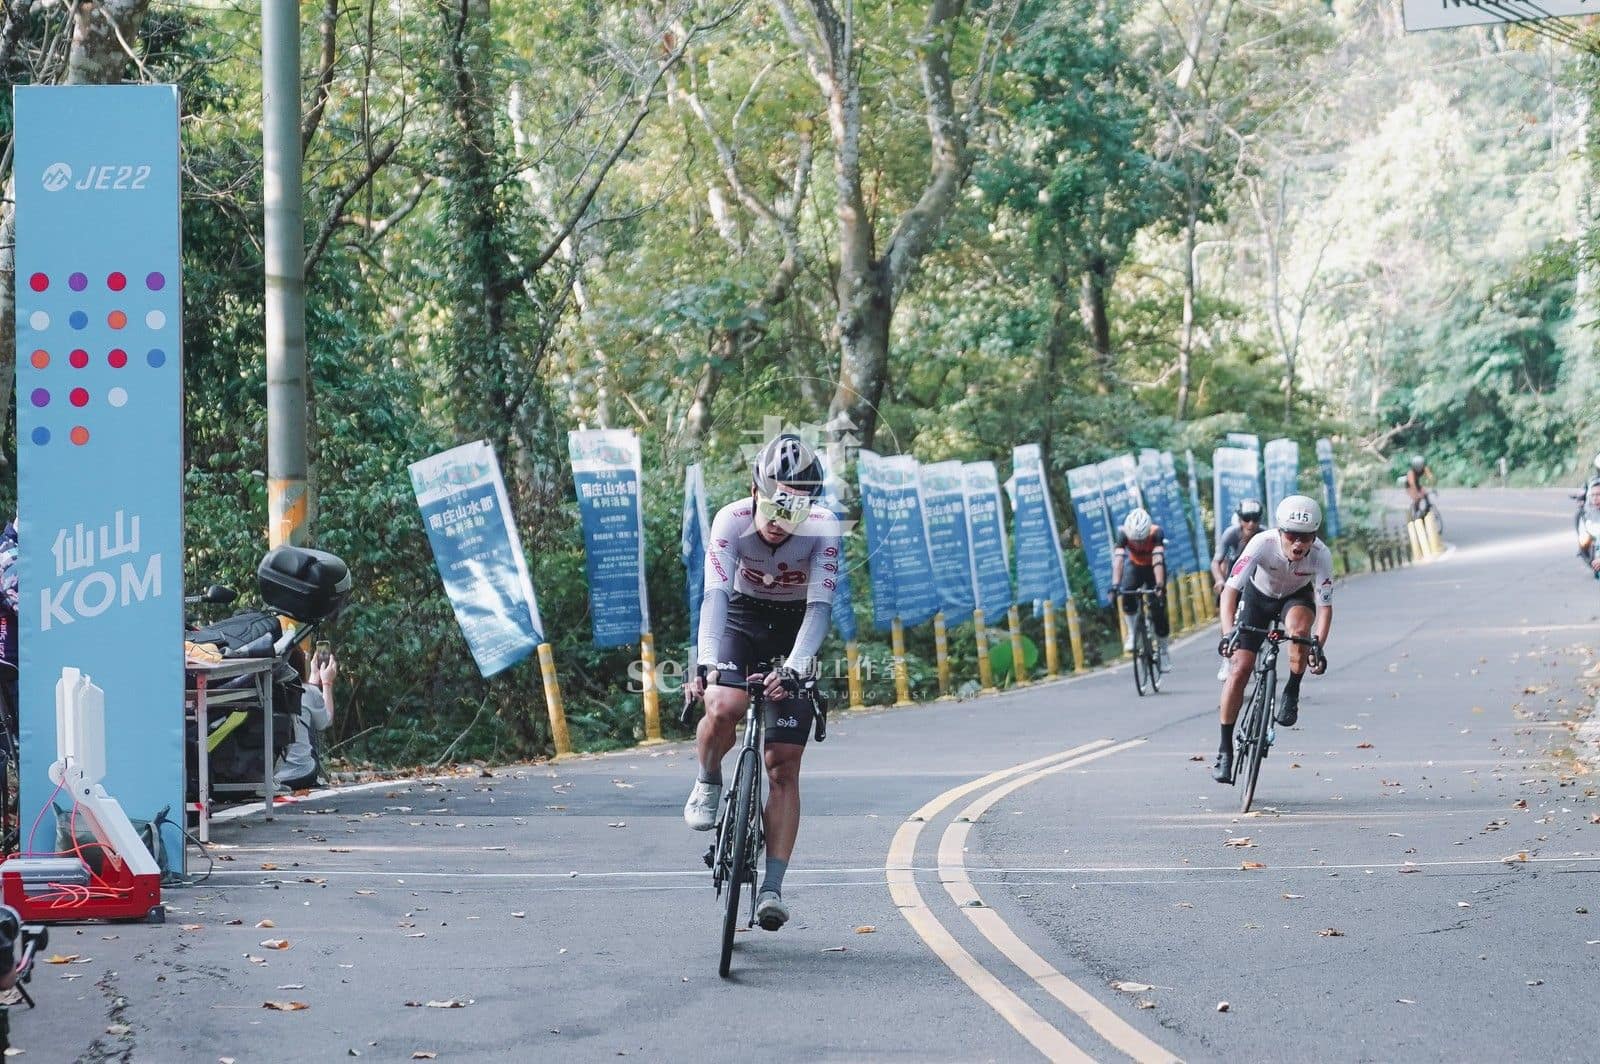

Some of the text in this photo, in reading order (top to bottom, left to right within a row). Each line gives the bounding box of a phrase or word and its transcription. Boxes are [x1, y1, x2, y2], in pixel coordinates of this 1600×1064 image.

[75, 165, 151, 190] JE22
[776, 492, 806, 511] 215
[1289, 512, 1309, 523] 415
[51, 510, 140, 577] 仙山
[40, 553, 161, 631] KOM
